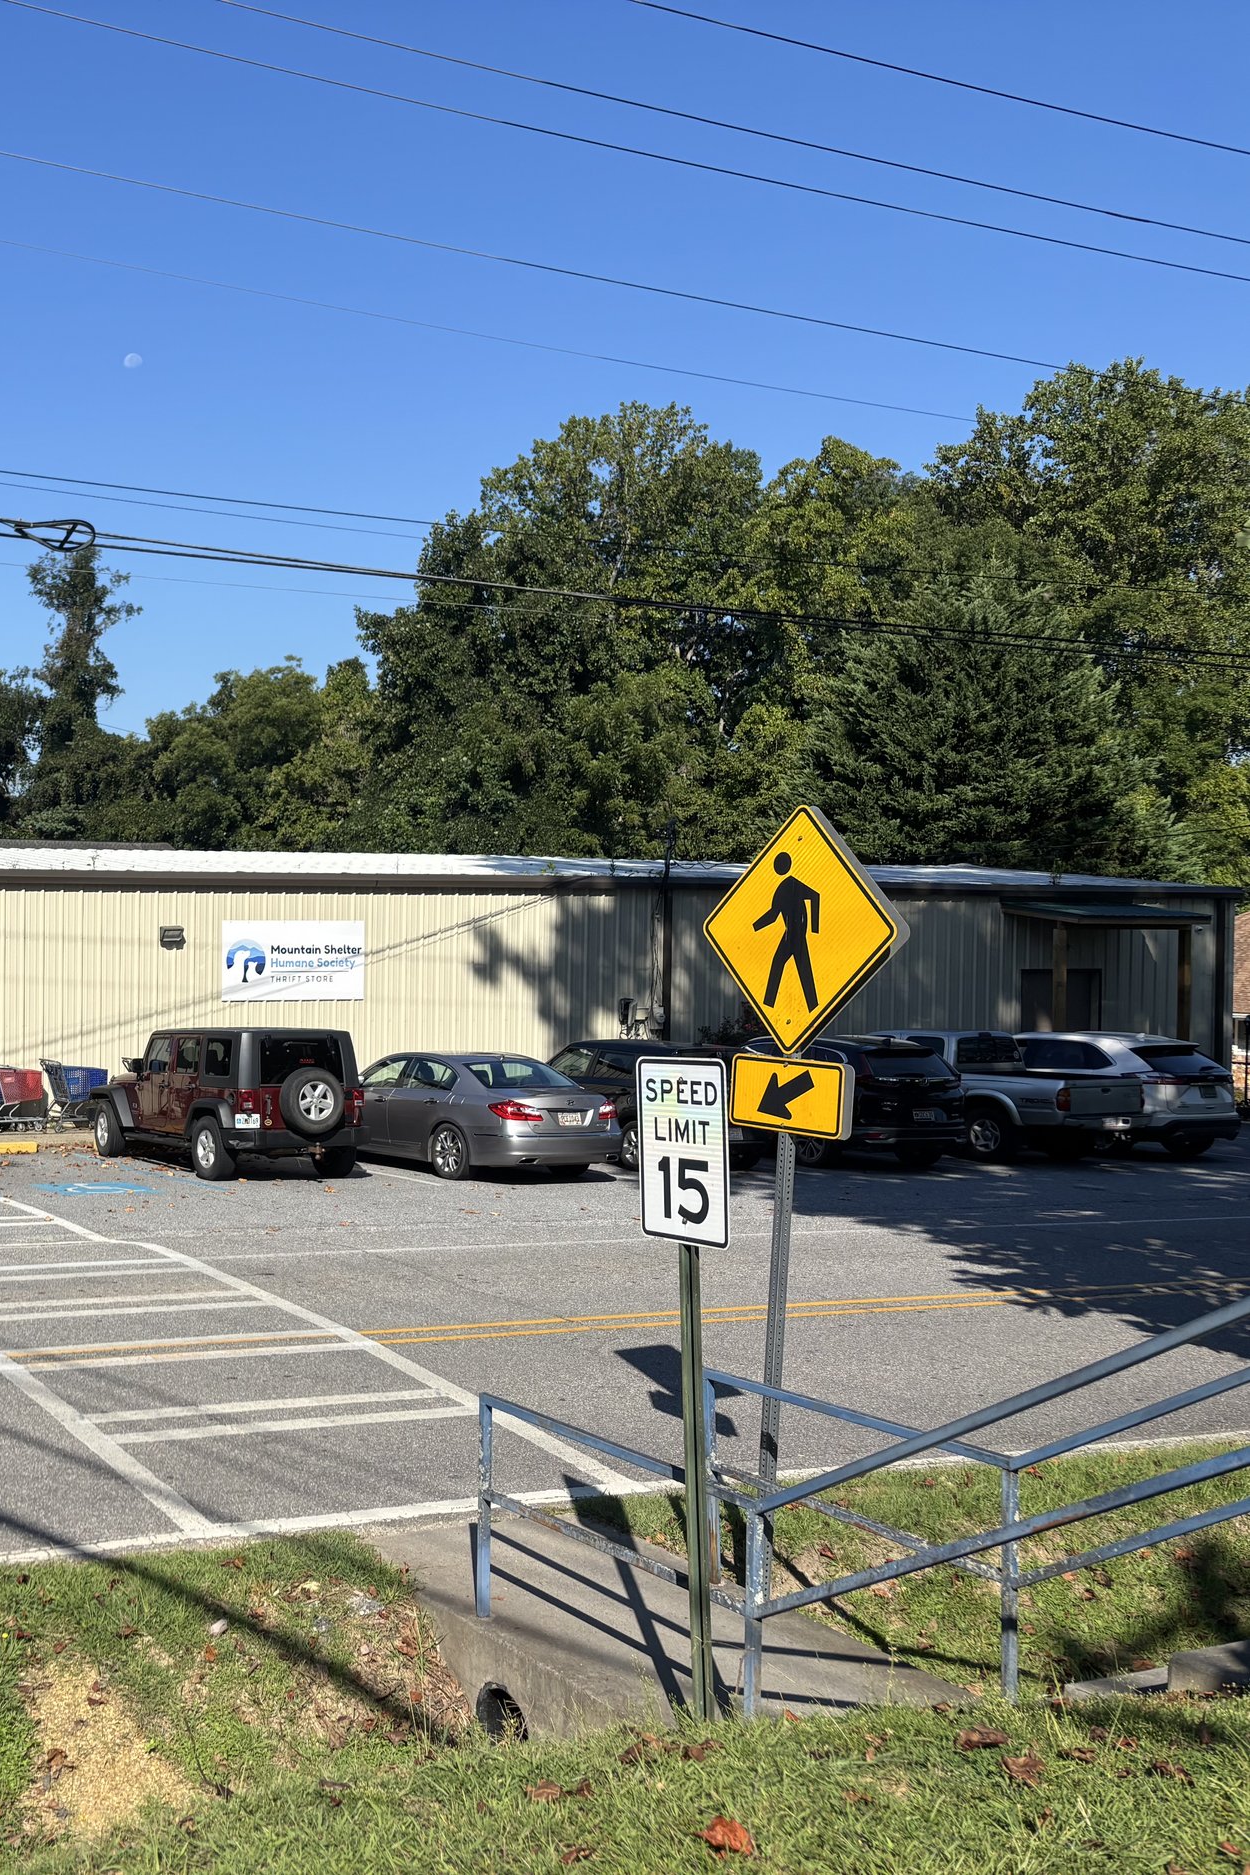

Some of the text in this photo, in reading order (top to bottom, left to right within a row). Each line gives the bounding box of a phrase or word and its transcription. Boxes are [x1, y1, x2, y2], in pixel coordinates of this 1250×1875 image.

[270, 943, 362, 955] Mountain Shelter
[270, 957, 356, 969] Humane Society
[270, 975, 334, 983] THRIFT STORE
[645, 1078, 718, 1106] SPEED
[654, 1117, 710, 1146] LIMIT
[658, 1155, 710, 1225] 15
